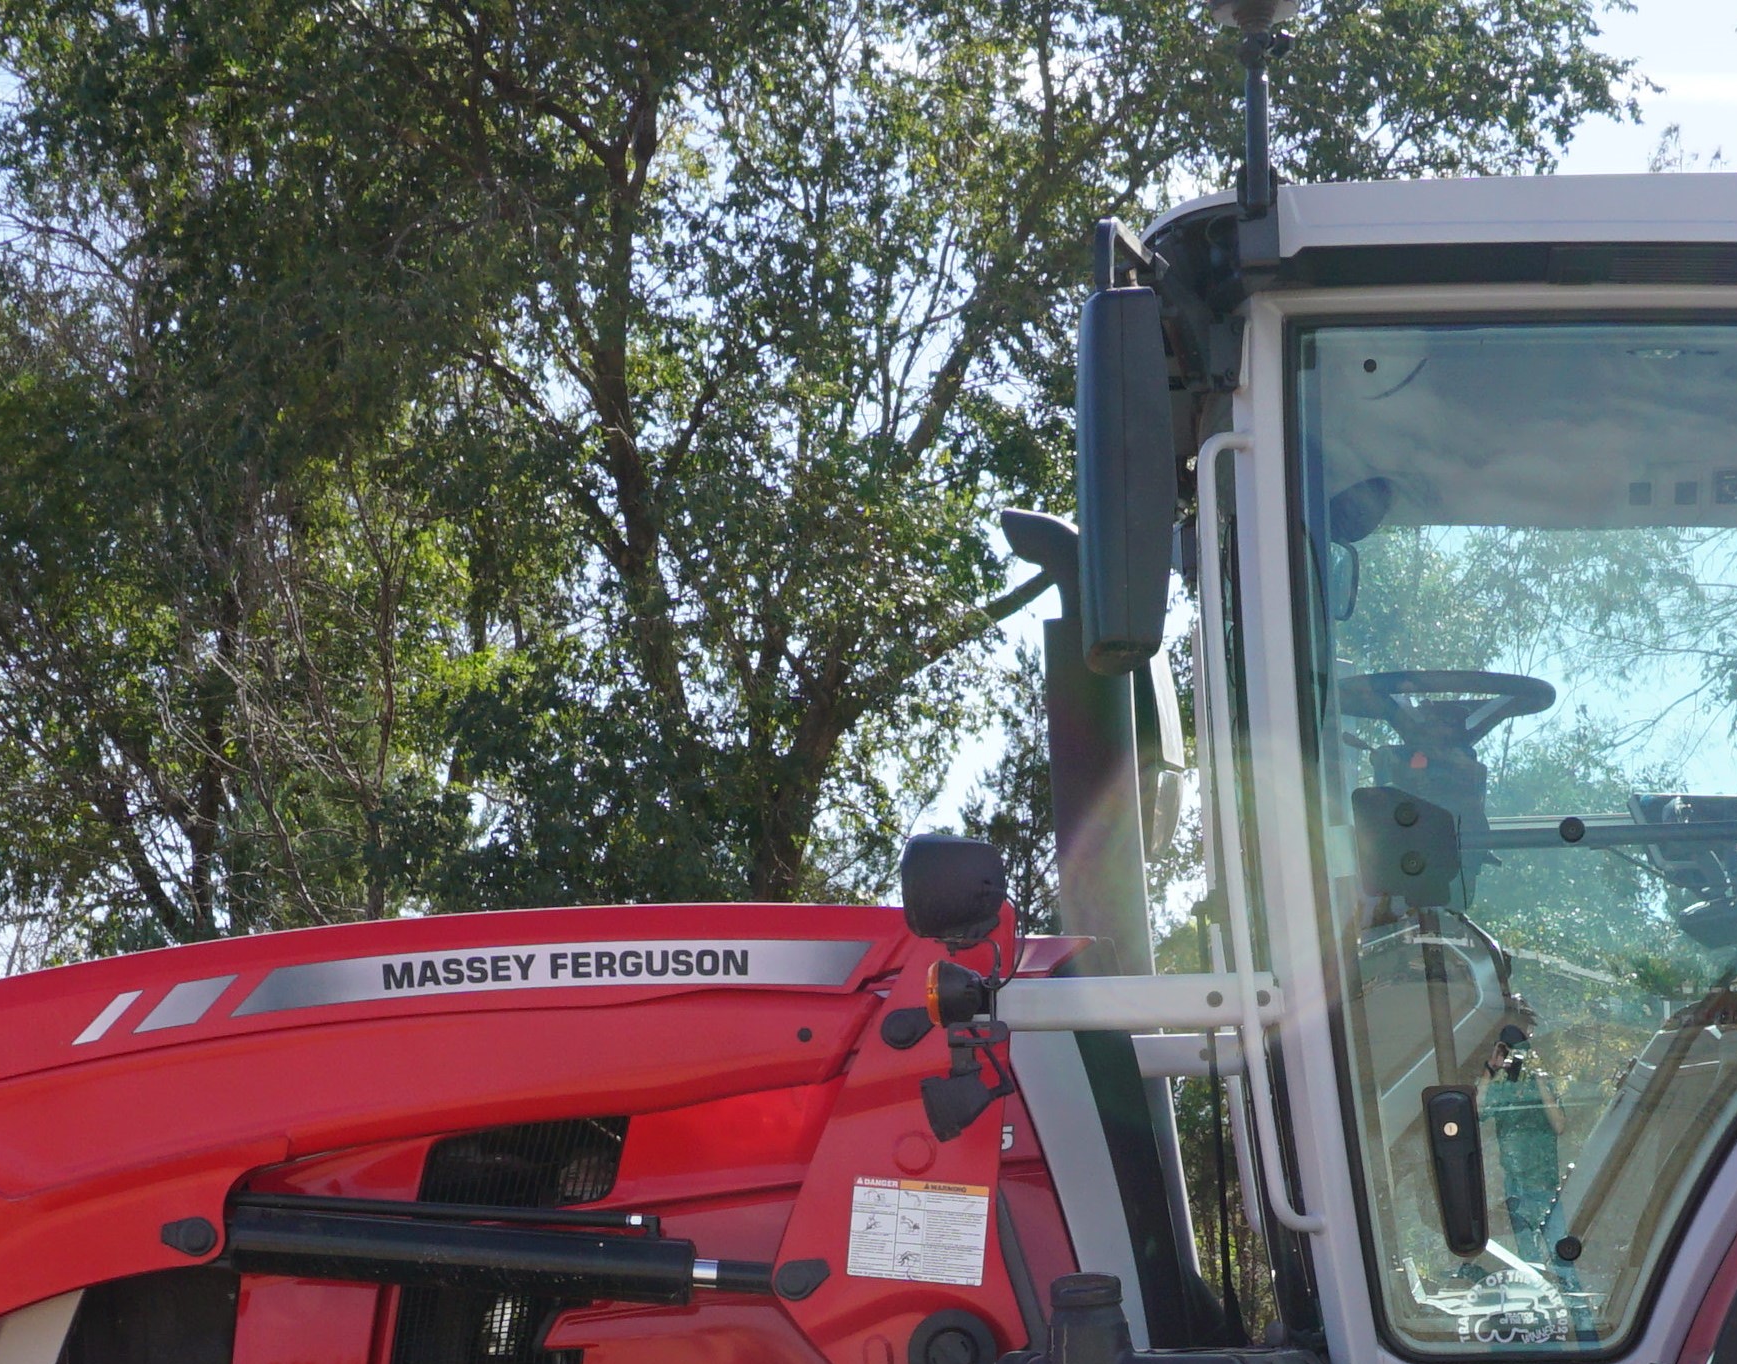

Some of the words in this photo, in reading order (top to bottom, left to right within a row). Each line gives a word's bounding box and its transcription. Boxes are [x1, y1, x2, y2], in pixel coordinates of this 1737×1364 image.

[382, 953, 536, 990] MASSEY
[550, 949, 749, 979] FERGUSON
[864, 1178, 899, 1187] DANGER
[930, 1185, 967, 1193] WARNING
[1457, 1283, 1483, 1344] TRATOR
